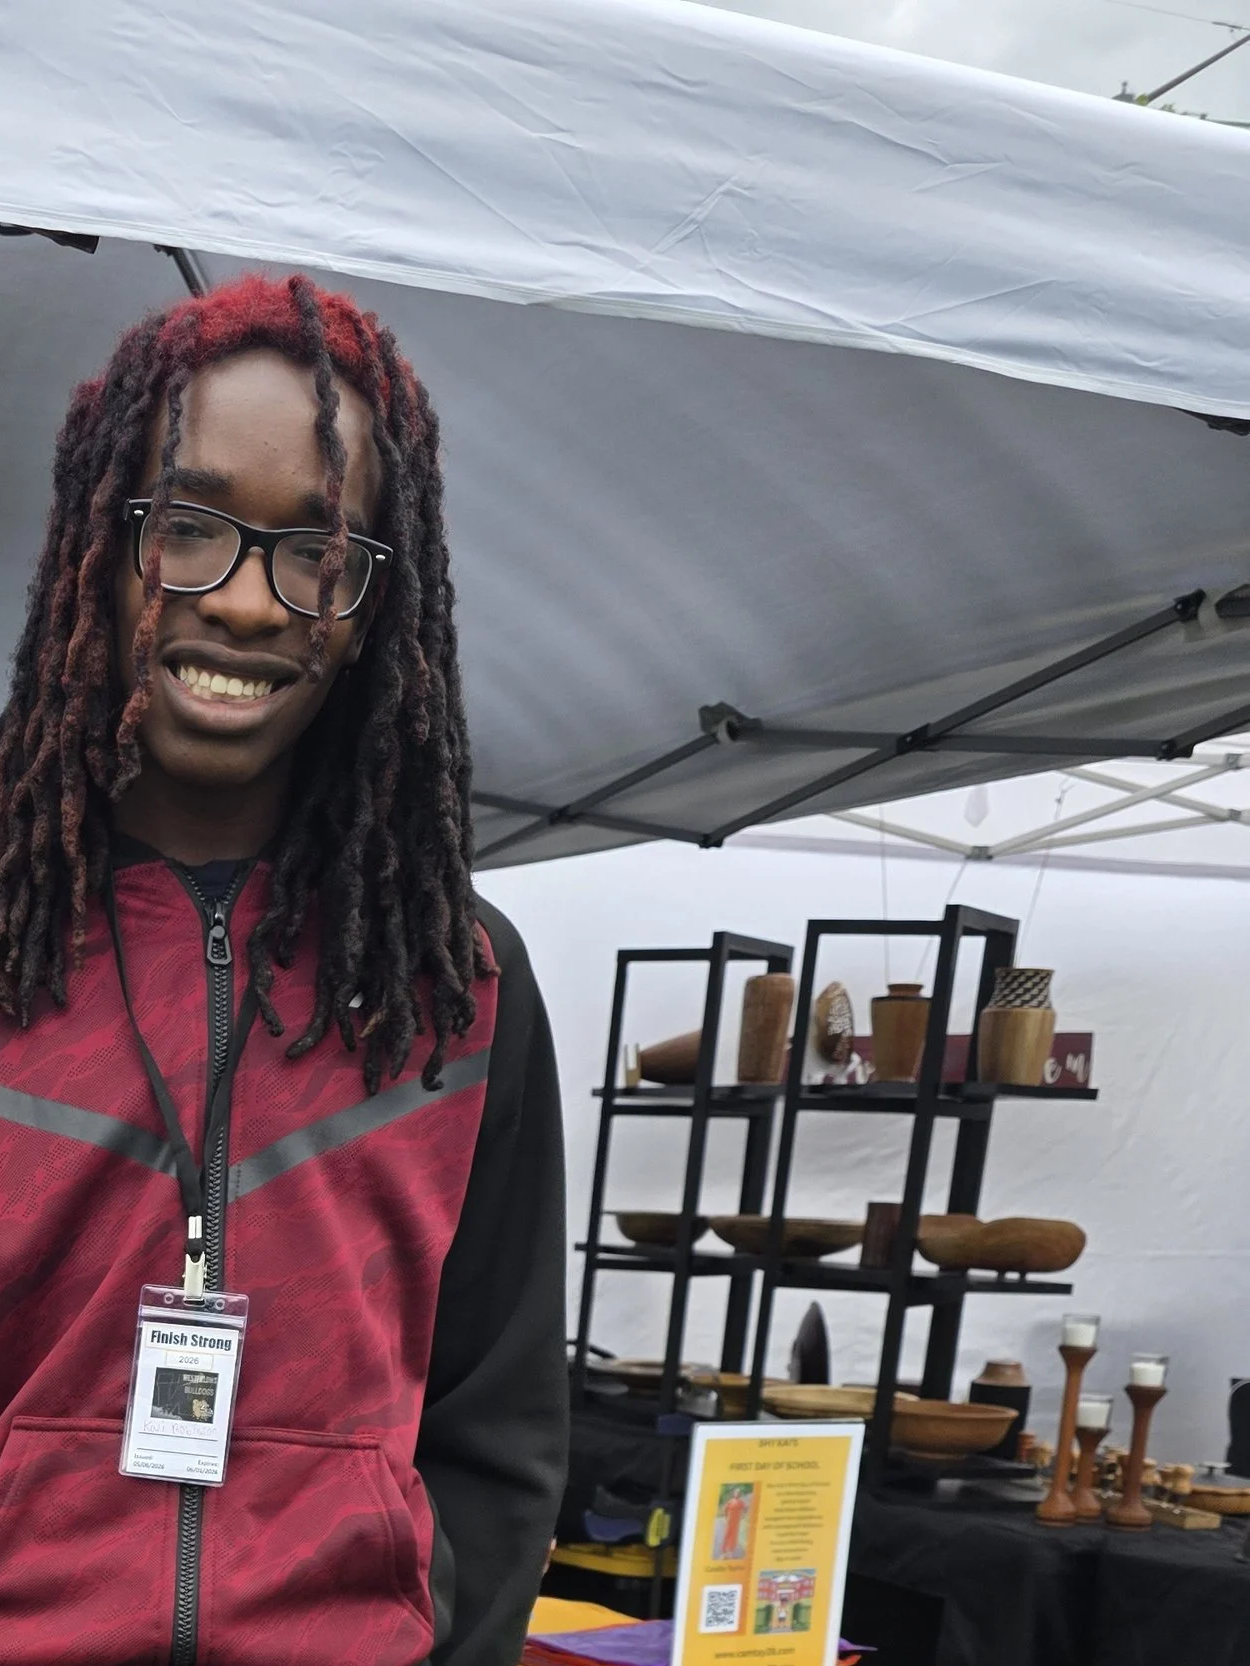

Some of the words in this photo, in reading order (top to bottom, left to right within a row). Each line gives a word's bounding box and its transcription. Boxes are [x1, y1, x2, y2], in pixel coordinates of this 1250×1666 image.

[151, 1330, 188, 1346] Finish
[190, 1334, 232, 1352] Strong
[178, 1355, 200, 1365] 2026
[184, 1386, 215, 1396] BULLDOGS
